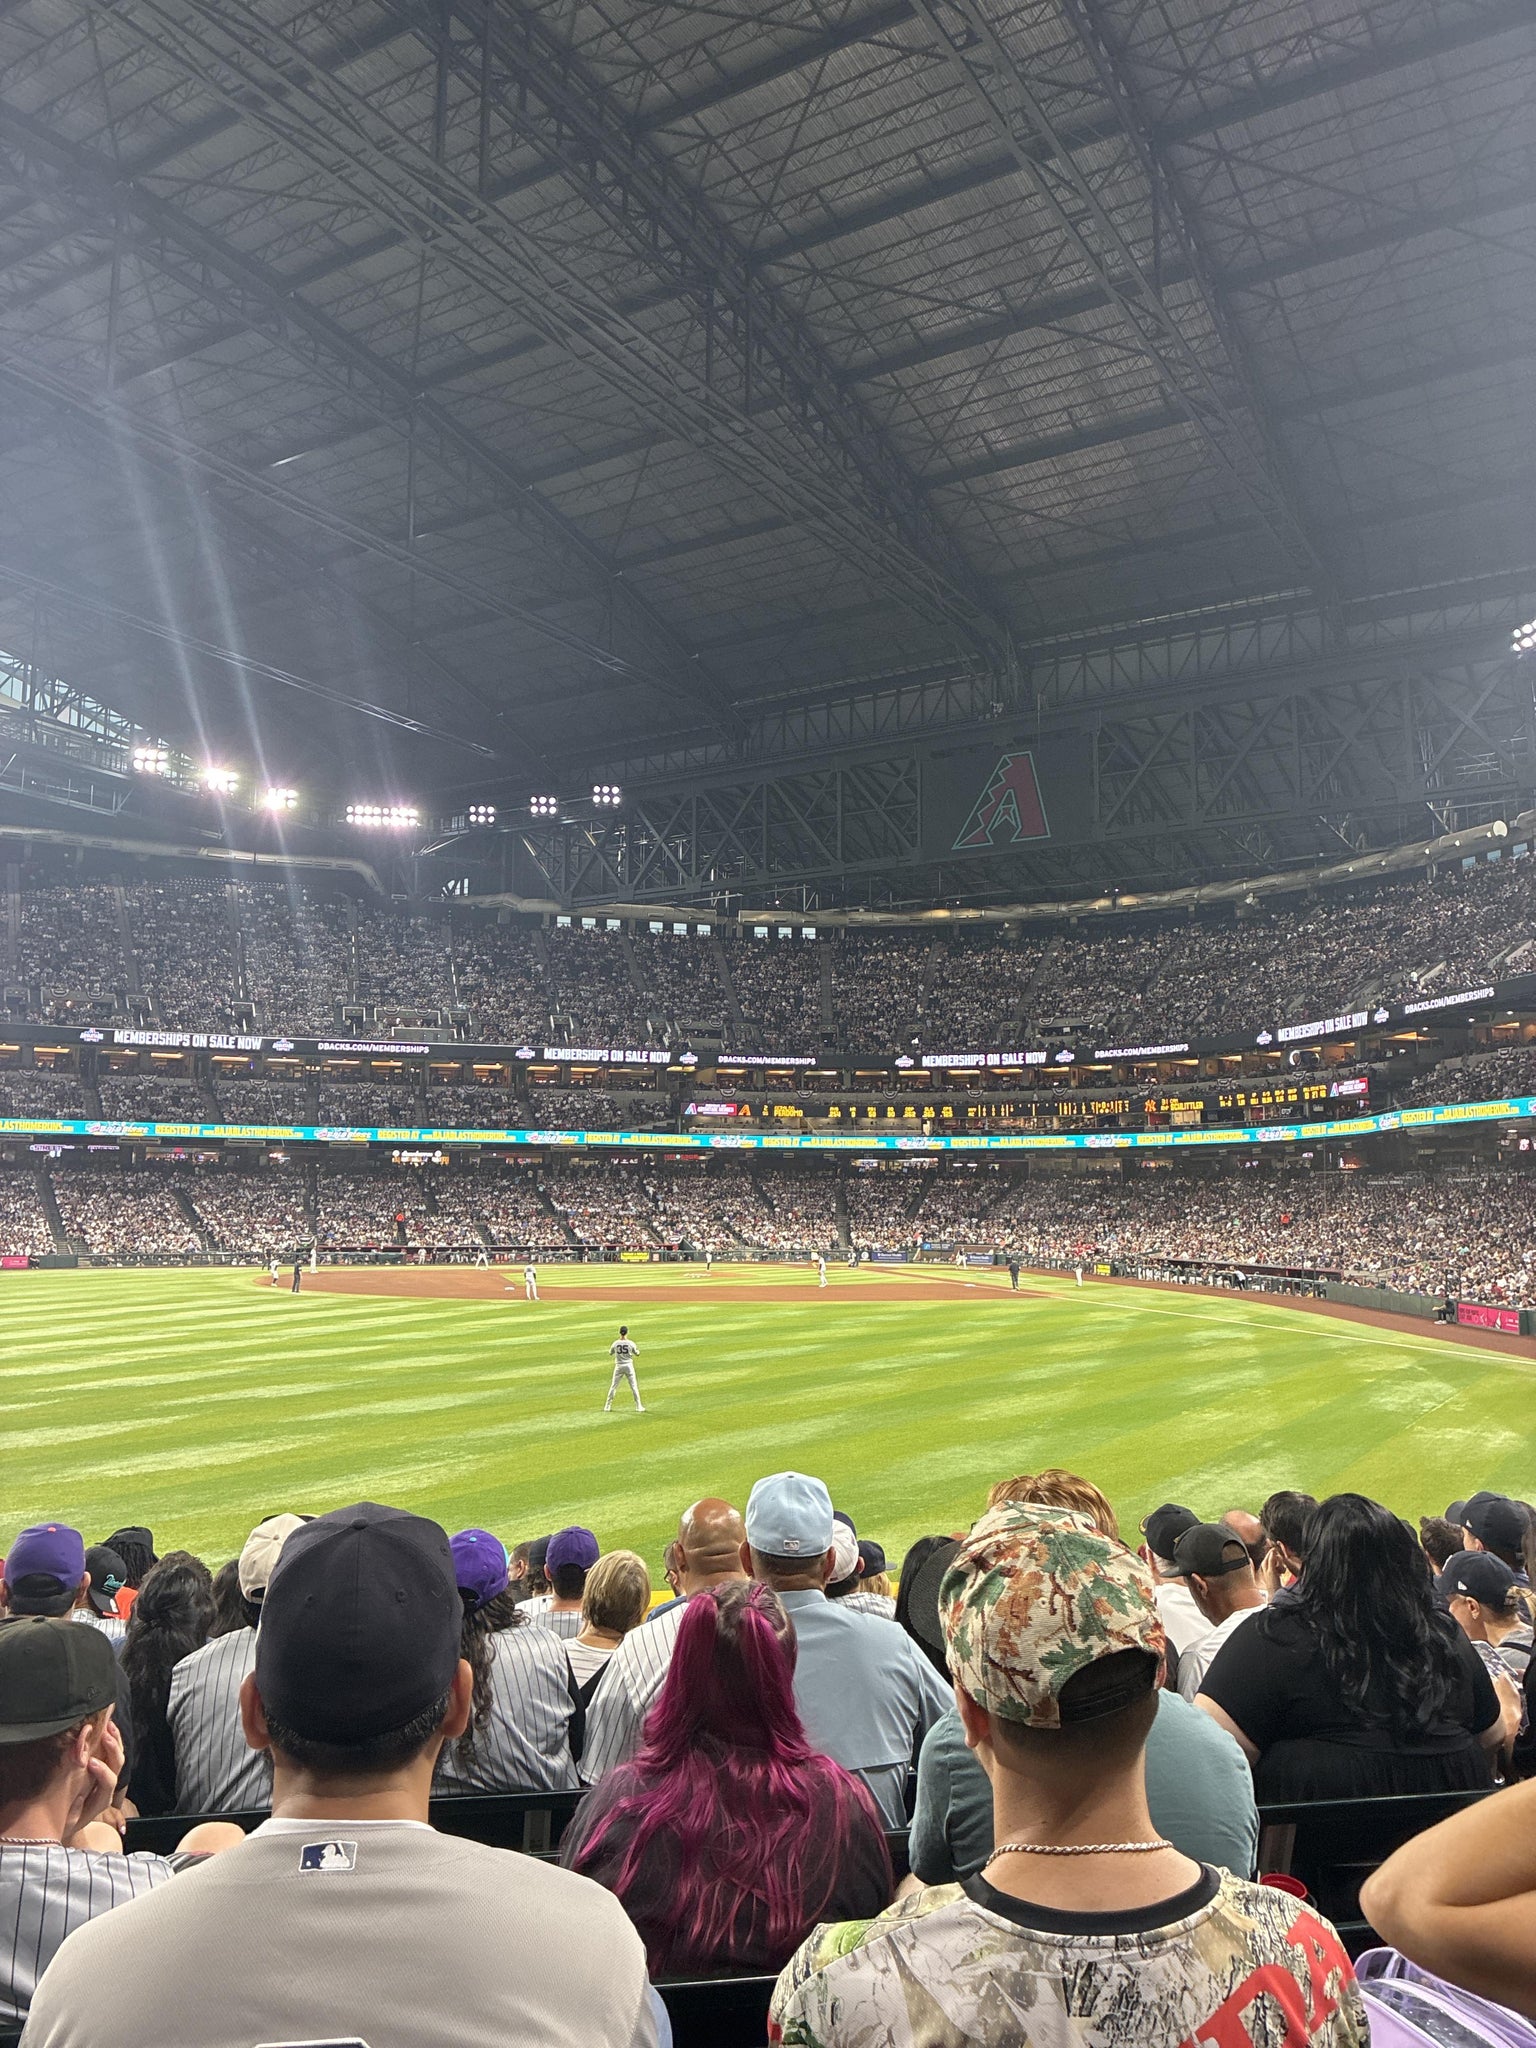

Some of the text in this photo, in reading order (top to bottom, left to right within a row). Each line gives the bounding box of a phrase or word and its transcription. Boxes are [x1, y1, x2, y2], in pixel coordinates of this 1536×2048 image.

[1404, 986, 1495, 1014] DBACKS.COM/MEMBERSHIPS
[1277, 1020, 1325, 1042] MEMBERSHIPS
[1324, 1018, 1335, 1034] ON
[1334, 1014, 1352, 1032] SALE
[1351, 1011, 1369, 1028] NOW
[113, 1029, 190, 1047] MEMBERSHIPS
[191, 1034, 207, 1048] ON
[208, 1034, 235, 1049] SALE
[236, 1036, 263, 1050] NOW
[317, 1042, 430, 1054] DBACKS.COM/MEMBERSHIPS
[543, 1047, 609, 1061] MEMBERSHIPS
[609, 1049, 624, 1061] ON
[624, 1050, 648, 1063] SALE
[649, 1051, 671, 1064] NOW
[717, 1054, 817, 1066] DBACKS.COM/MEMBERSHIPS
[921, 1054, 986, 1068] MEMBERSHIPS
[986, 1053, 1001, 1066] ON
[1001, 1052, 1025, 1066] SALE
[1025, 1051, 1047, 1065] NOW
[1094, 1043, 1189, 1060] DBACKS.COM/MEMBERSHIPS
[155, 1125, 191, 1136] REGISTER
[191, 1126, 201, 1136] AT
[377, 1130, 411, 1140] REGISTER
[411, 1131, 420, 1140] AT
[616, 1344, 629, 1355] 35
